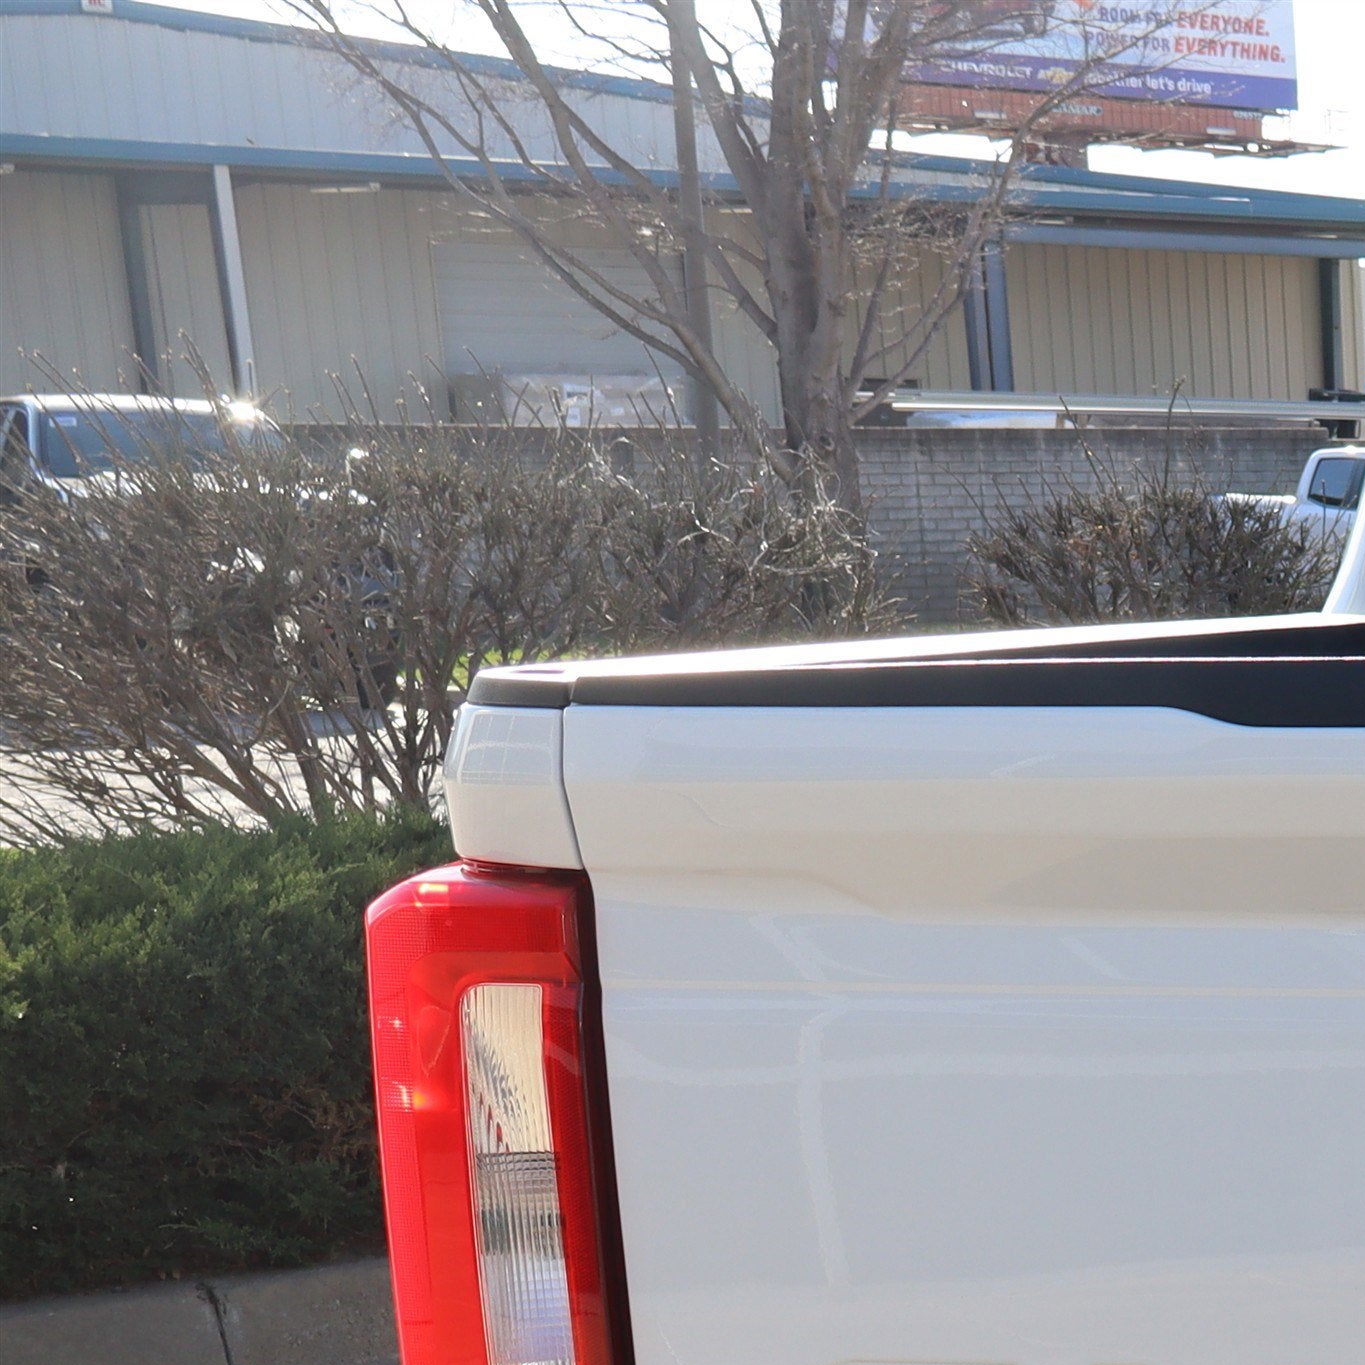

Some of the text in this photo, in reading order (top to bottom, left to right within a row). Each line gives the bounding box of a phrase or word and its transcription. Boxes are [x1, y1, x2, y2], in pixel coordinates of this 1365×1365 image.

[1176, 11, 1270, 37] EVERYONE.
[1174, 36, 1286, 63] EVERYTHING.
[1145, 74, 1175, 92] let's
[1177, 78, 1213, 94] drive
